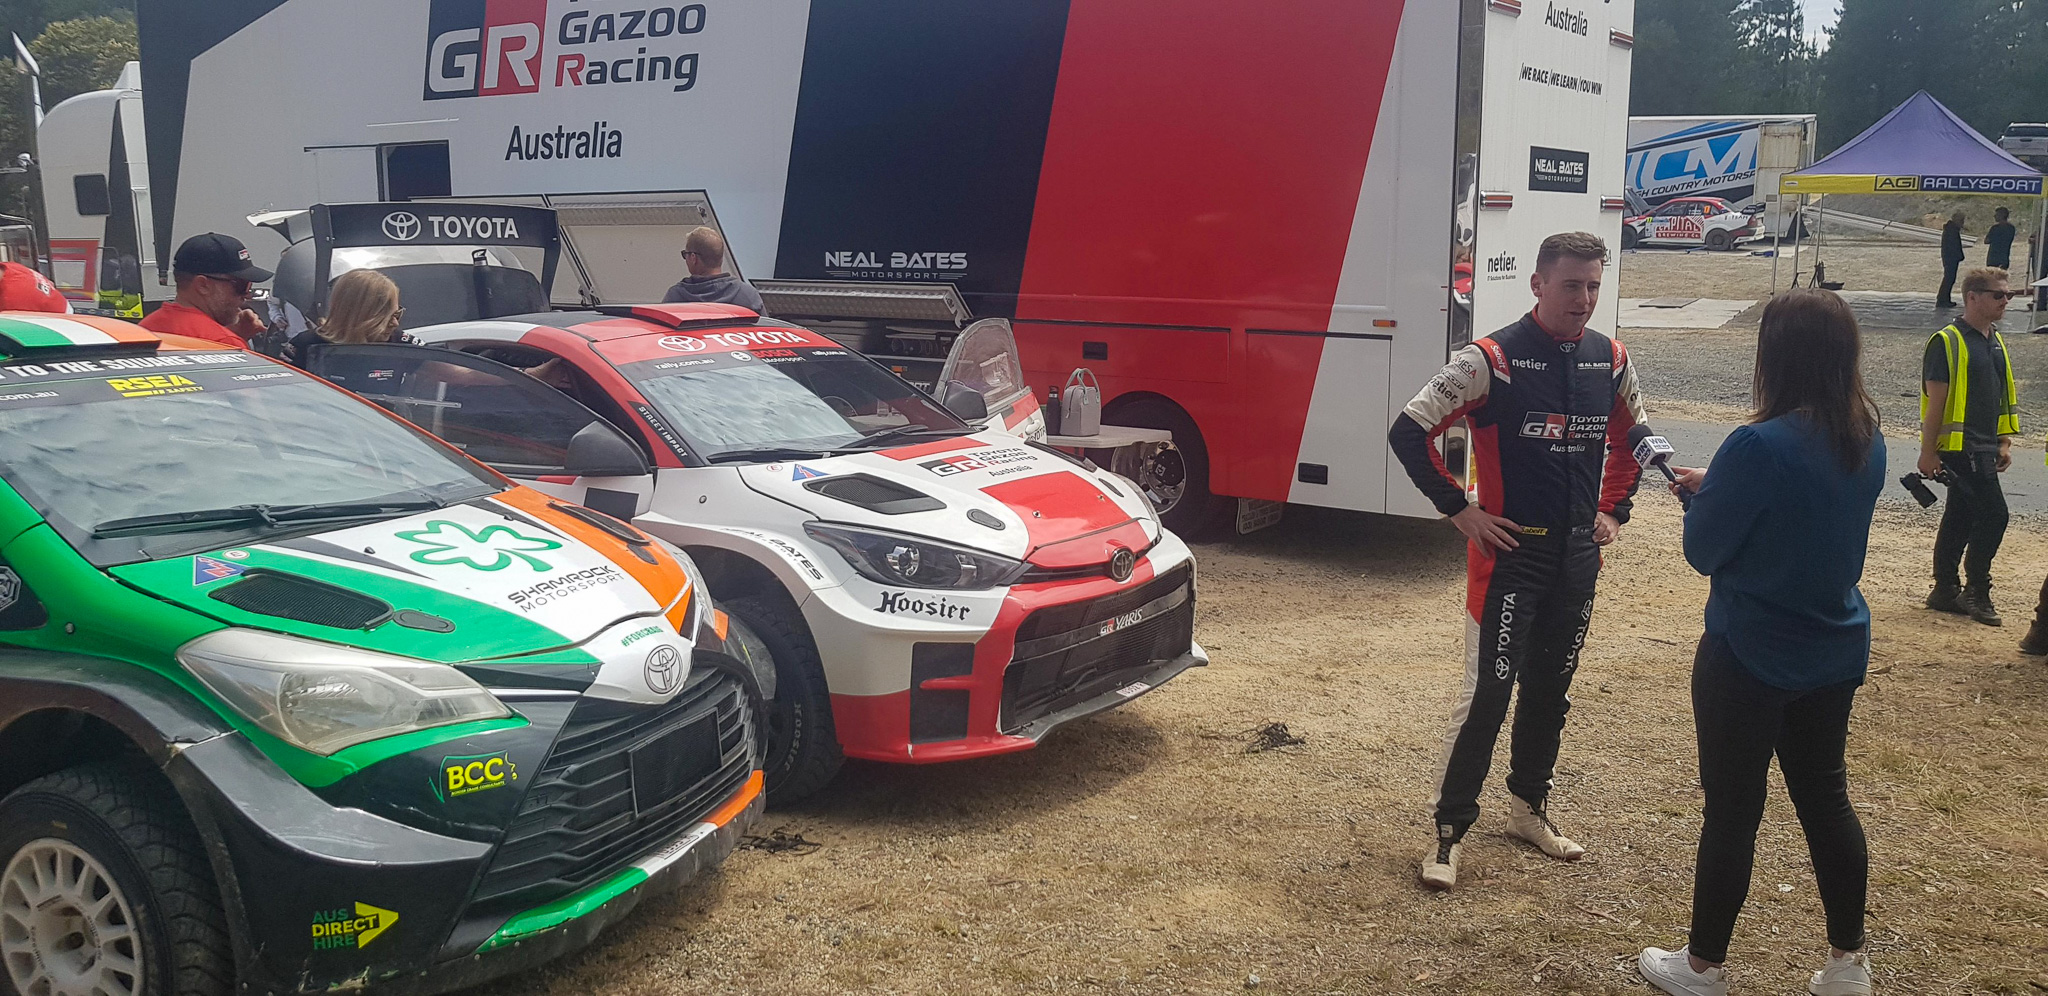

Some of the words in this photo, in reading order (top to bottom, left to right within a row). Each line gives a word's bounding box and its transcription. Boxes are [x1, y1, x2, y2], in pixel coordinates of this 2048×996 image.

[558, 4, 707, 45] GAZOO
[1545, 0, 1588, 37] Australia
[428, 22, 540, 93] GR
[554, 47, 699, 92] Racing
[1532, 68, 1549, 84] RACE
[1560, 74, 1578, 90] LEARN
[505, 121, 622, 161] Australia
[1534, 158, 1557, 173] NEAL
[1559, 161, 1584, 175] BATES
[1544, 175, 1574, 183] MOTORSPORT
[1651, 180, 1701, 195] COUNTRY
[1878, 178, 1917, 189] AGI
[1923, 178, 2040, 192] RALLYSPORT
[428, 215, 519, 239] TOYOTA
[825, 251, 884, 268] NEAL
[890, 252, 968, 269] BATES
[1487, 250, 1517, 272] netier.
[852, 271, 939, 279] MOTORSPORT
[703, 331, 810, 347] TOYOTA
[752, 349, 798, 358] BOSCH
[4, 364, 49, 377] TO
[45, 360, 105, 374] THE
[99, 354, 194, 370] SQUARE
[654, 358, 715, 370] rally.com.au
[106, 375, 197, 391] RSEA
[638, 405, 665, 431] STREET
[662, 431, 688, 456] IMPACT
[1523, 422, 1564, 438] GR
[1567, 431, 1603, 440] Racing
[1568, 423, 1606, 431] GAZOO
[968, 447, 1023, 457] TOYOTA
[979, 451, 1028, 461] GAZOO
[1550, 443, 1586, 452] Australia
[1634, 441, 1648, 459] WIN
[930, 459, 981, 476] GR
[988, 454, 1038, 466] Racing
[988, 464, 1033, 477] Australia
[768, 538, 824, 580] BATES
[507, 565, 617, 604] SHAMROCK
[520, 573, 624, 612] MOTORSPORT
[873, 591, 971, 621] Hoosier
[1100, 622, 1114, 634] GR
[1116, 609, 1142, 630] YARIS
[1497, 592, 1517, 652] TOYOTA
[446, 757, 504, 790] BCC
[312, 908, 348, 923] AUS
[312, 915, 377, 937] DIRECT
[314, 933, 355, 950] HIRE
